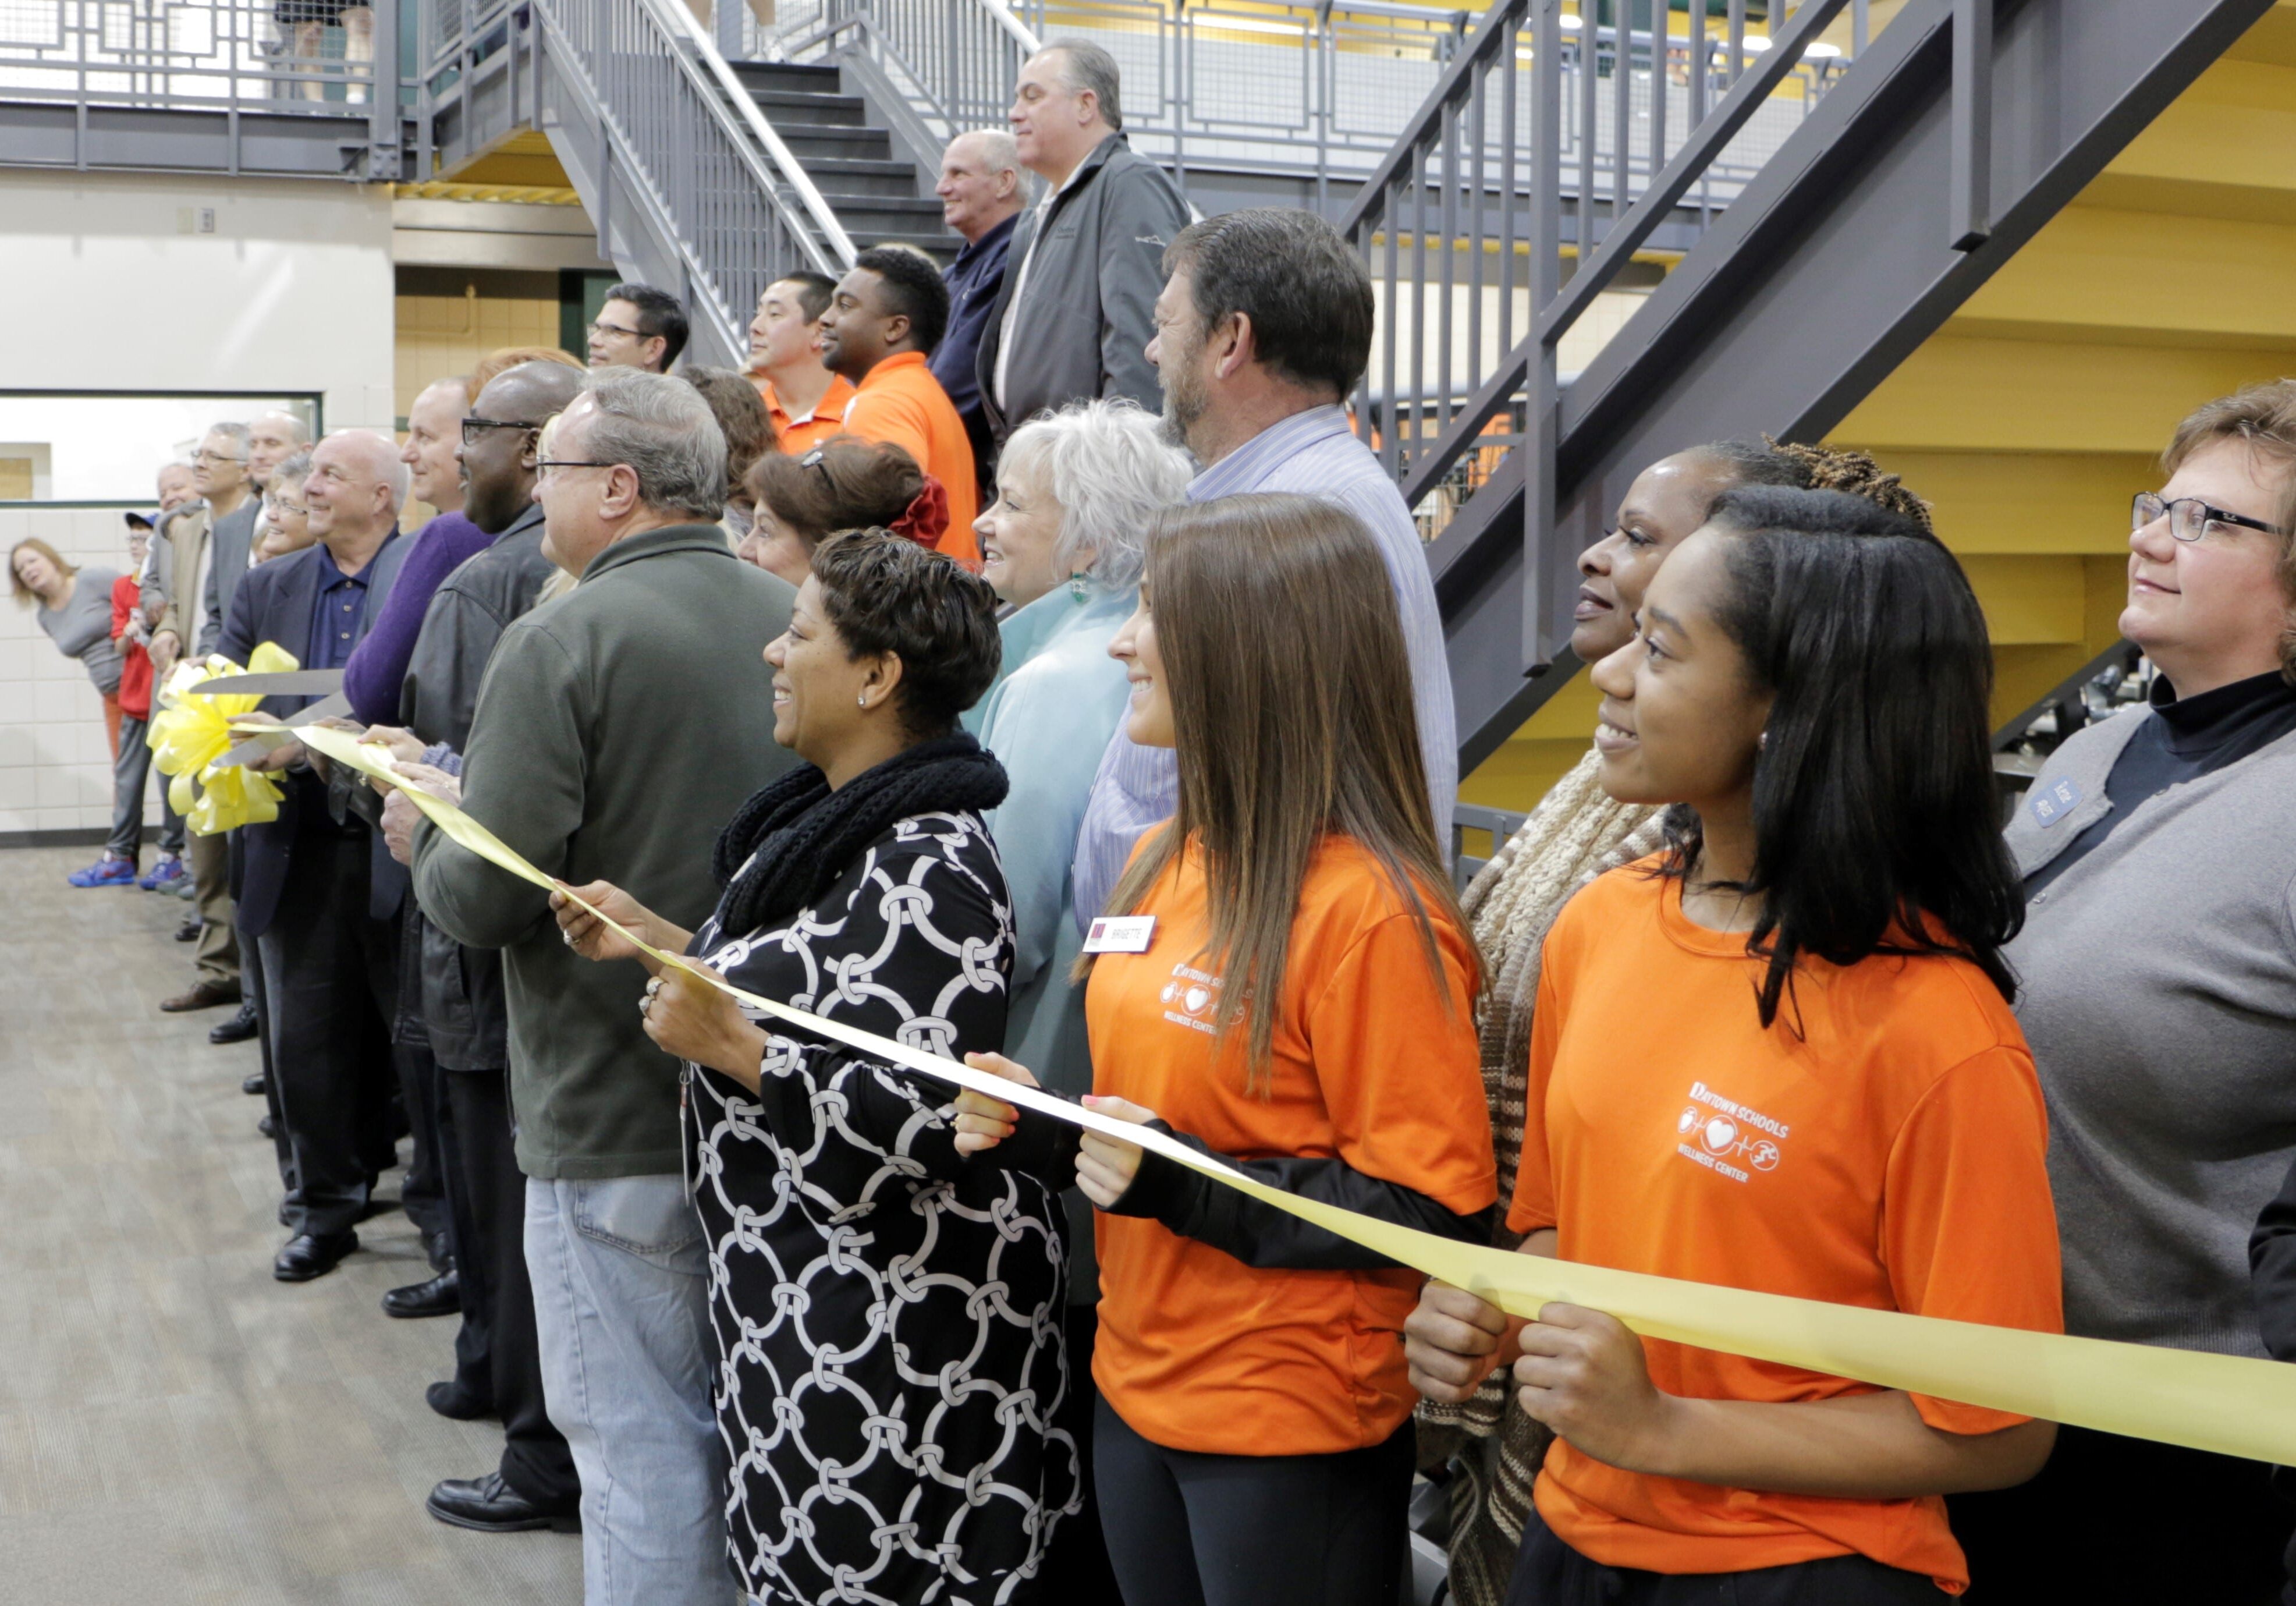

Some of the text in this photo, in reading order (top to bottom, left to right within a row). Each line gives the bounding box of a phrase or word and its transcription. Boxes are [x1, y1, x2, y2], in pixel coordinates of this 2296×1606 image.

[1736, 1107, 1789, 1139] SCHOOLS
[1677, 1142, 1749, 1183] WELLNESS CENTER
